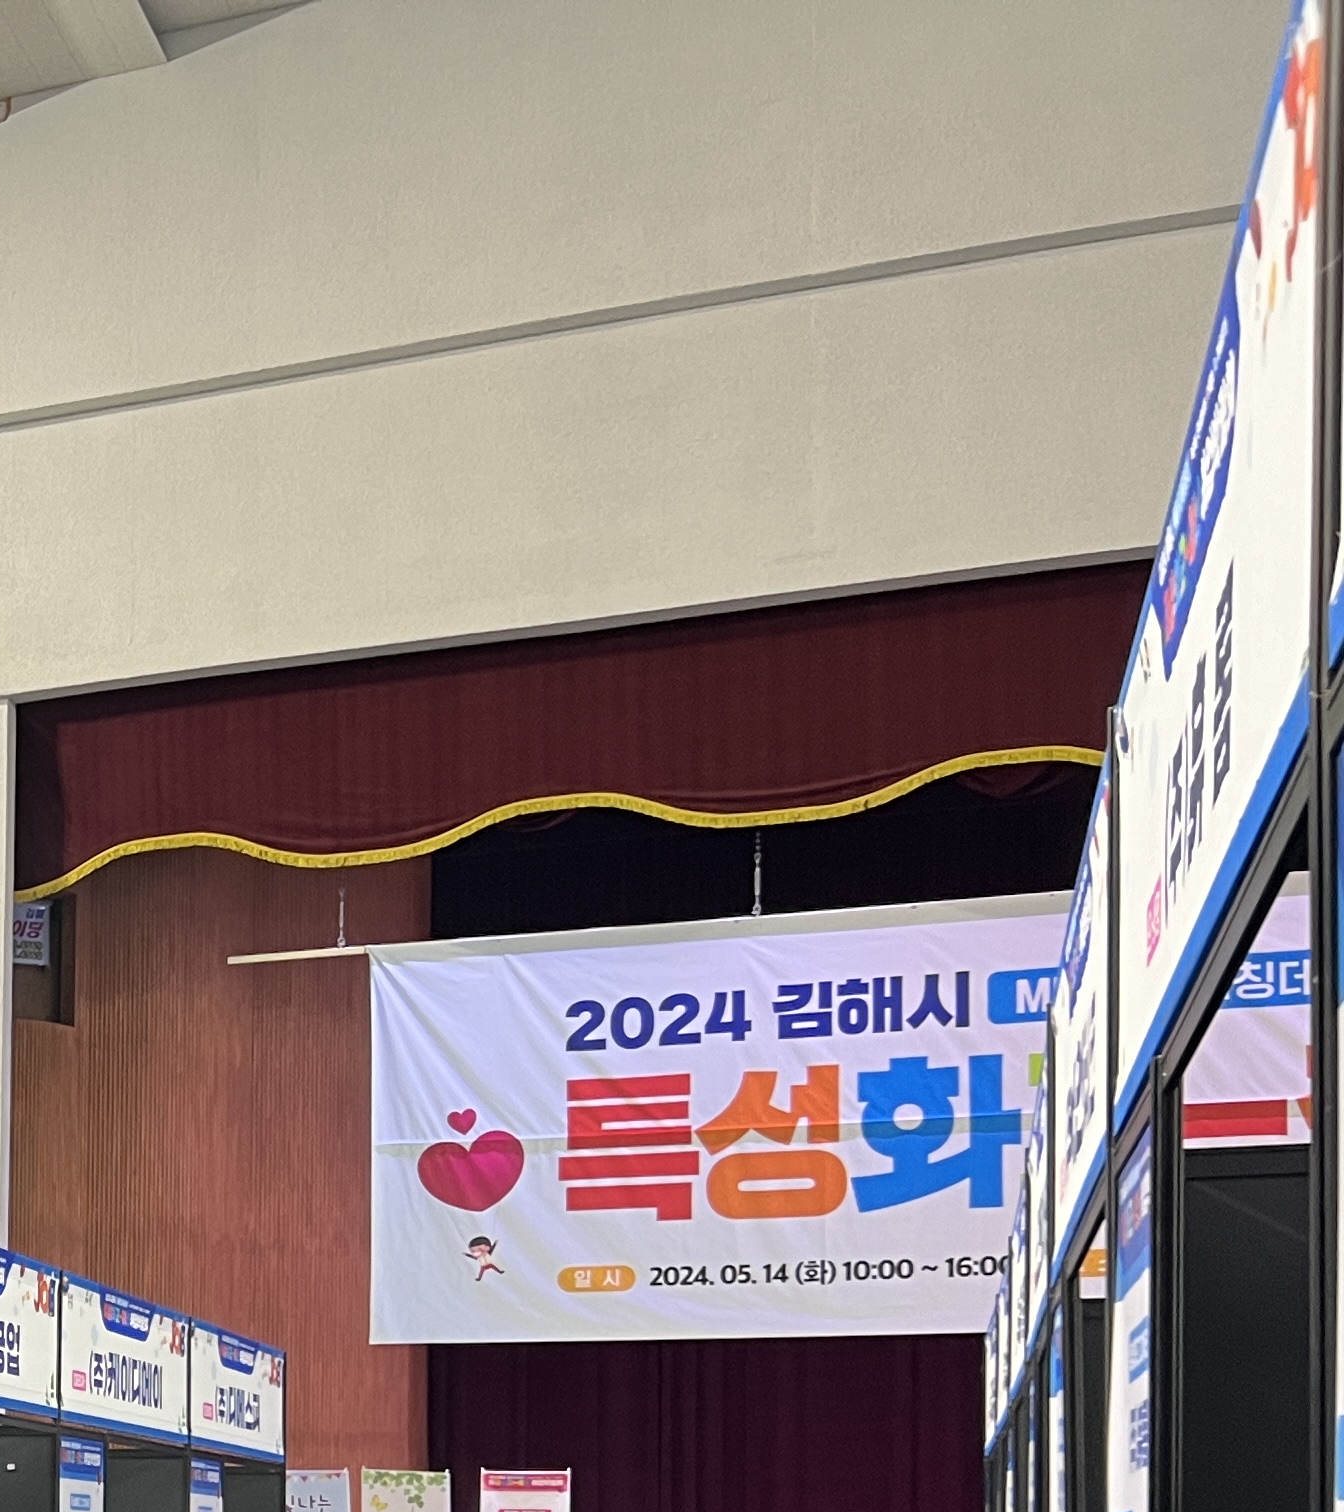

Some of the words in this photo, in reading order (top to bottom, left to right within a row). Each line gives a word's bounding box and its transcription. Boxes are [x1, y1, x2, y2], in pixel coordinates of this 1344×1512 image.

[565, 989, 752, 1053] 2024
[772, 970, 972, 1040] 김해시
[558, 1052, 1045, 1221] 특성화
[649, 1264, 715, 1287] 2024.
[720, 1262, 754, 1285] 05.
[758, 1261, 789, 1284] 14
[793, 1259, 837, 1287] (화)
[842, 1257, 914, 1282] 10:00
